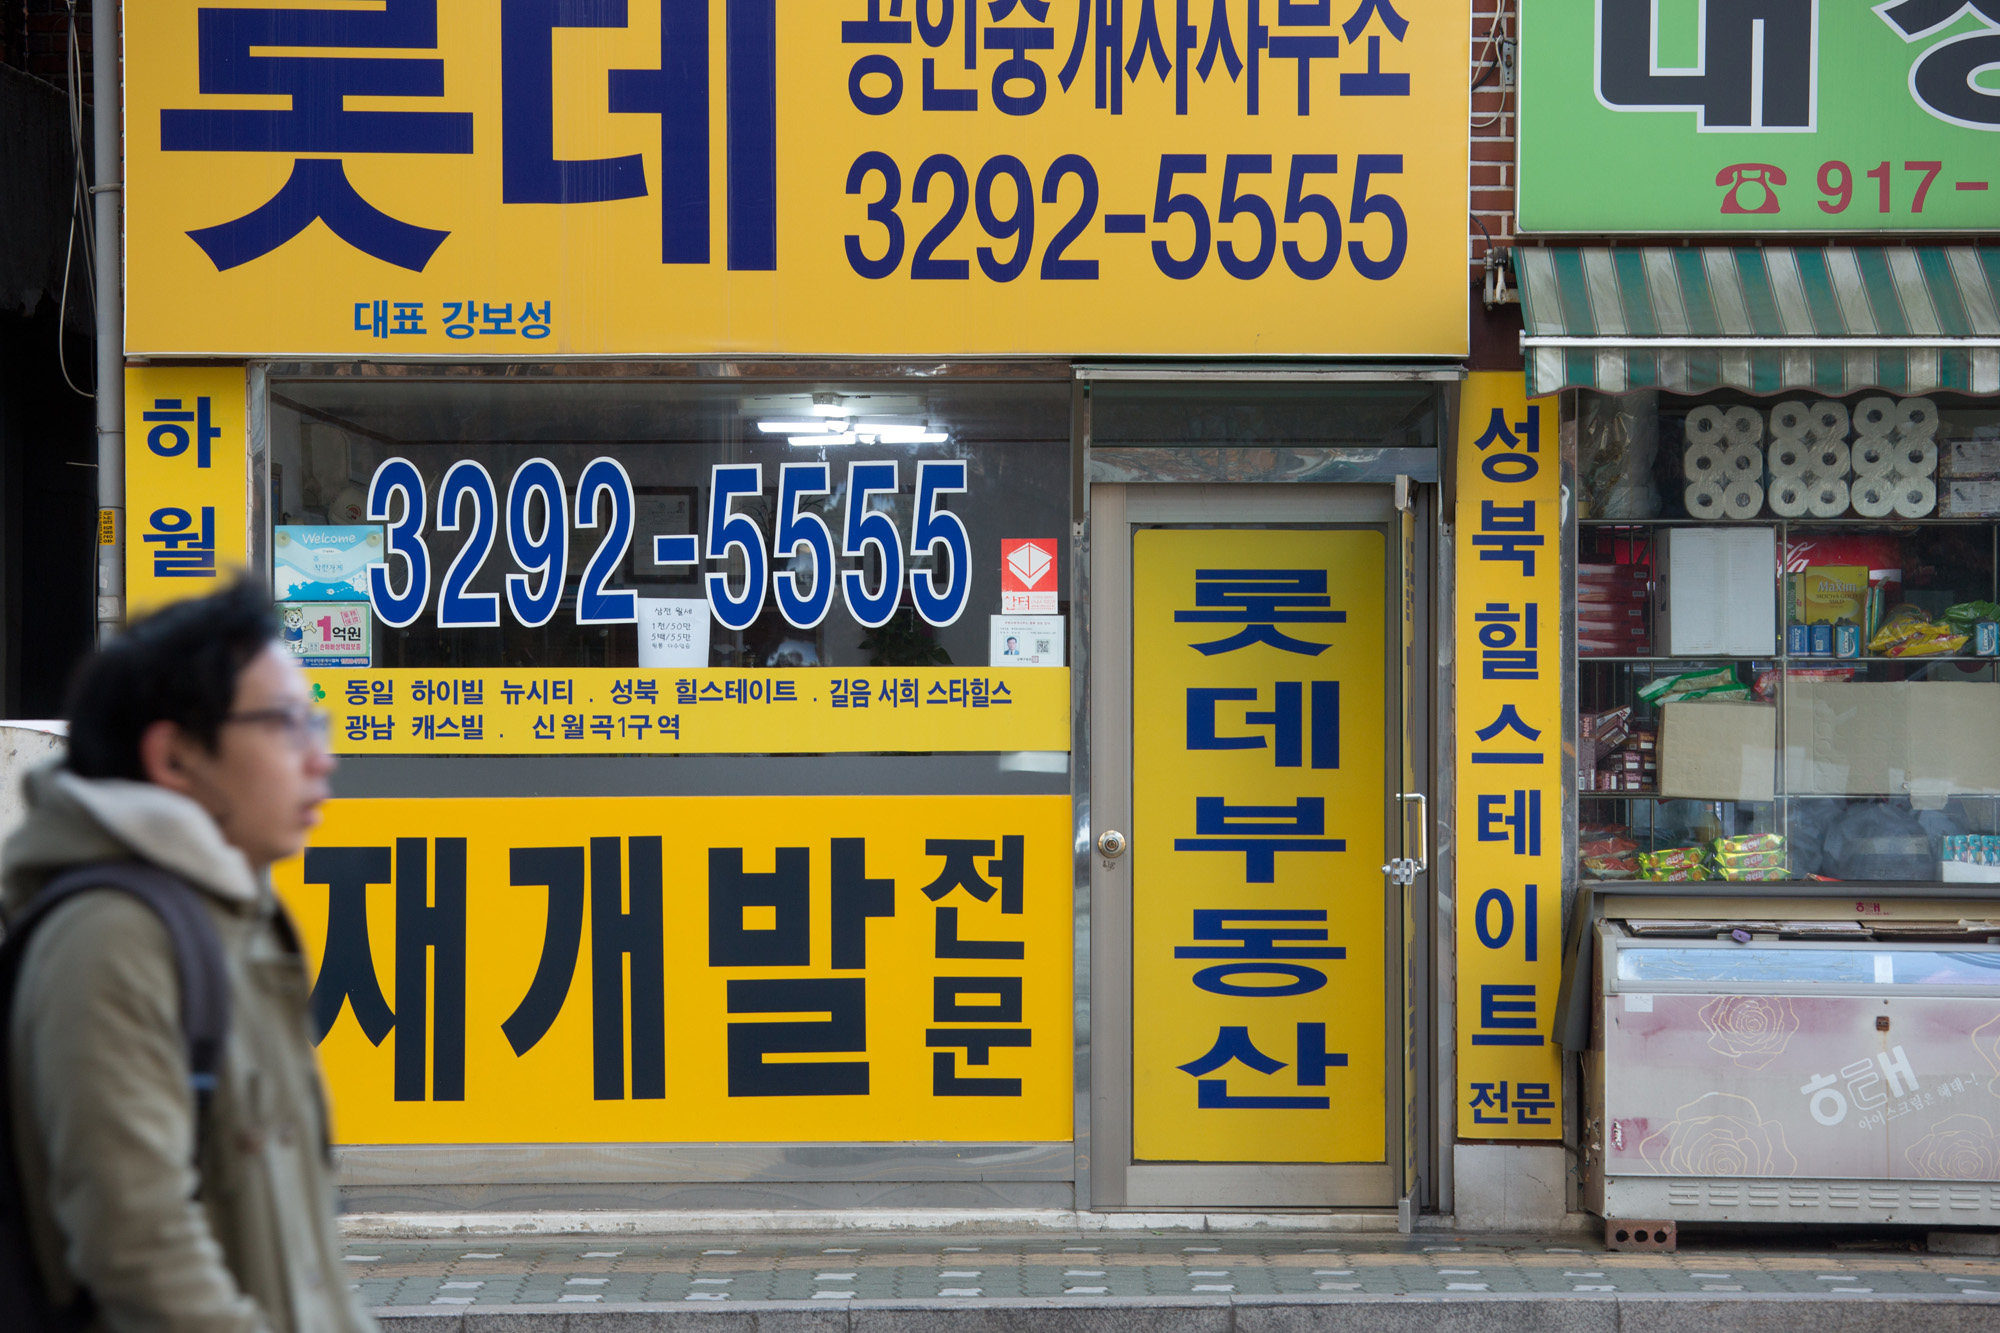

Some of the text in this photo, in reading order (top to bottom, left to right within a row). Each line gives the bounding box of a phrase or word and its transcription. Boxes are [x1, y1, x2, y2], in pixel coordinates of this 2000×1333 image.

[842, 0, 1411, 116] 공인중개사사무소
[160, 0, 777, 273] 롯데
[844, 151, 1408, 283] 3292-5555
[354, 299, 551, 340] 대표 강보성
[302, 532, 356, 545] Welcome
[367, 456, 972, 630] 3292-5555
[1818, 581, 1857, 592] Maxim
[317, 615, 361, 642] 1억원
[345, 678, 1012, 708] 동일 하이빌 뉴시티 성북 힐스테이트 길음 서희 스타힐스
[345, 713, 680, 741] 광남 캐스빌 신월곡1구역
[1174, 569, 1348, 1109] 롯데부동산
[304, 834, 1032, 1102] 재개발 전문
[1469, 1080, 1556, 1125] 전문
[1858, 1092, 1936, 1131] 아이스크림은
